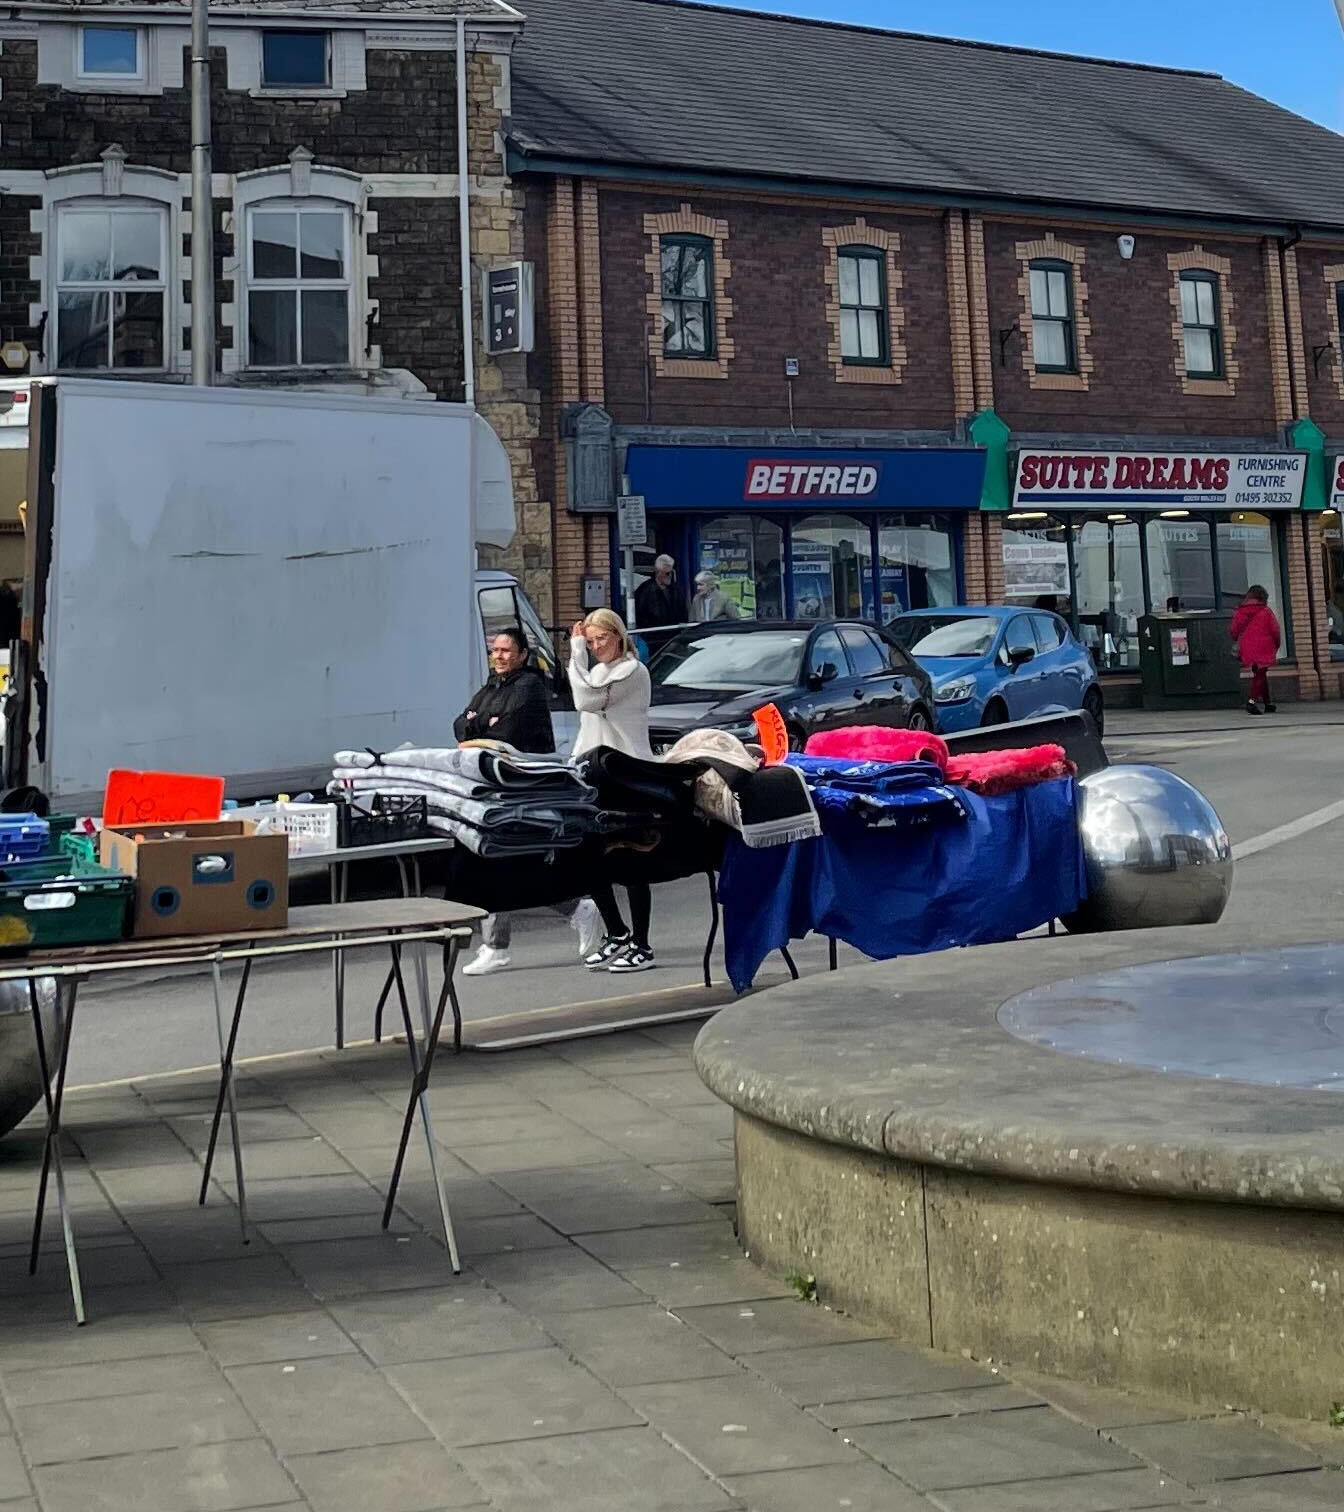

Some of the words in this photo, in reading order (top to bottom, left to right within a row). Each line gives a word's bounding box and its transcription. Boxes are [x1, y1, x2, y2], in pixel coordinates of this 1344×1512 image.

[1019, 455, 1110, 491] SUITE
[1112, 456, 1231, 492] DREAMS
[1236, 457, 1300, 472] FURNISHING
[748, 464, 878, 495] BETFRED
[1246, 474, 1287, 488] CENTRE
